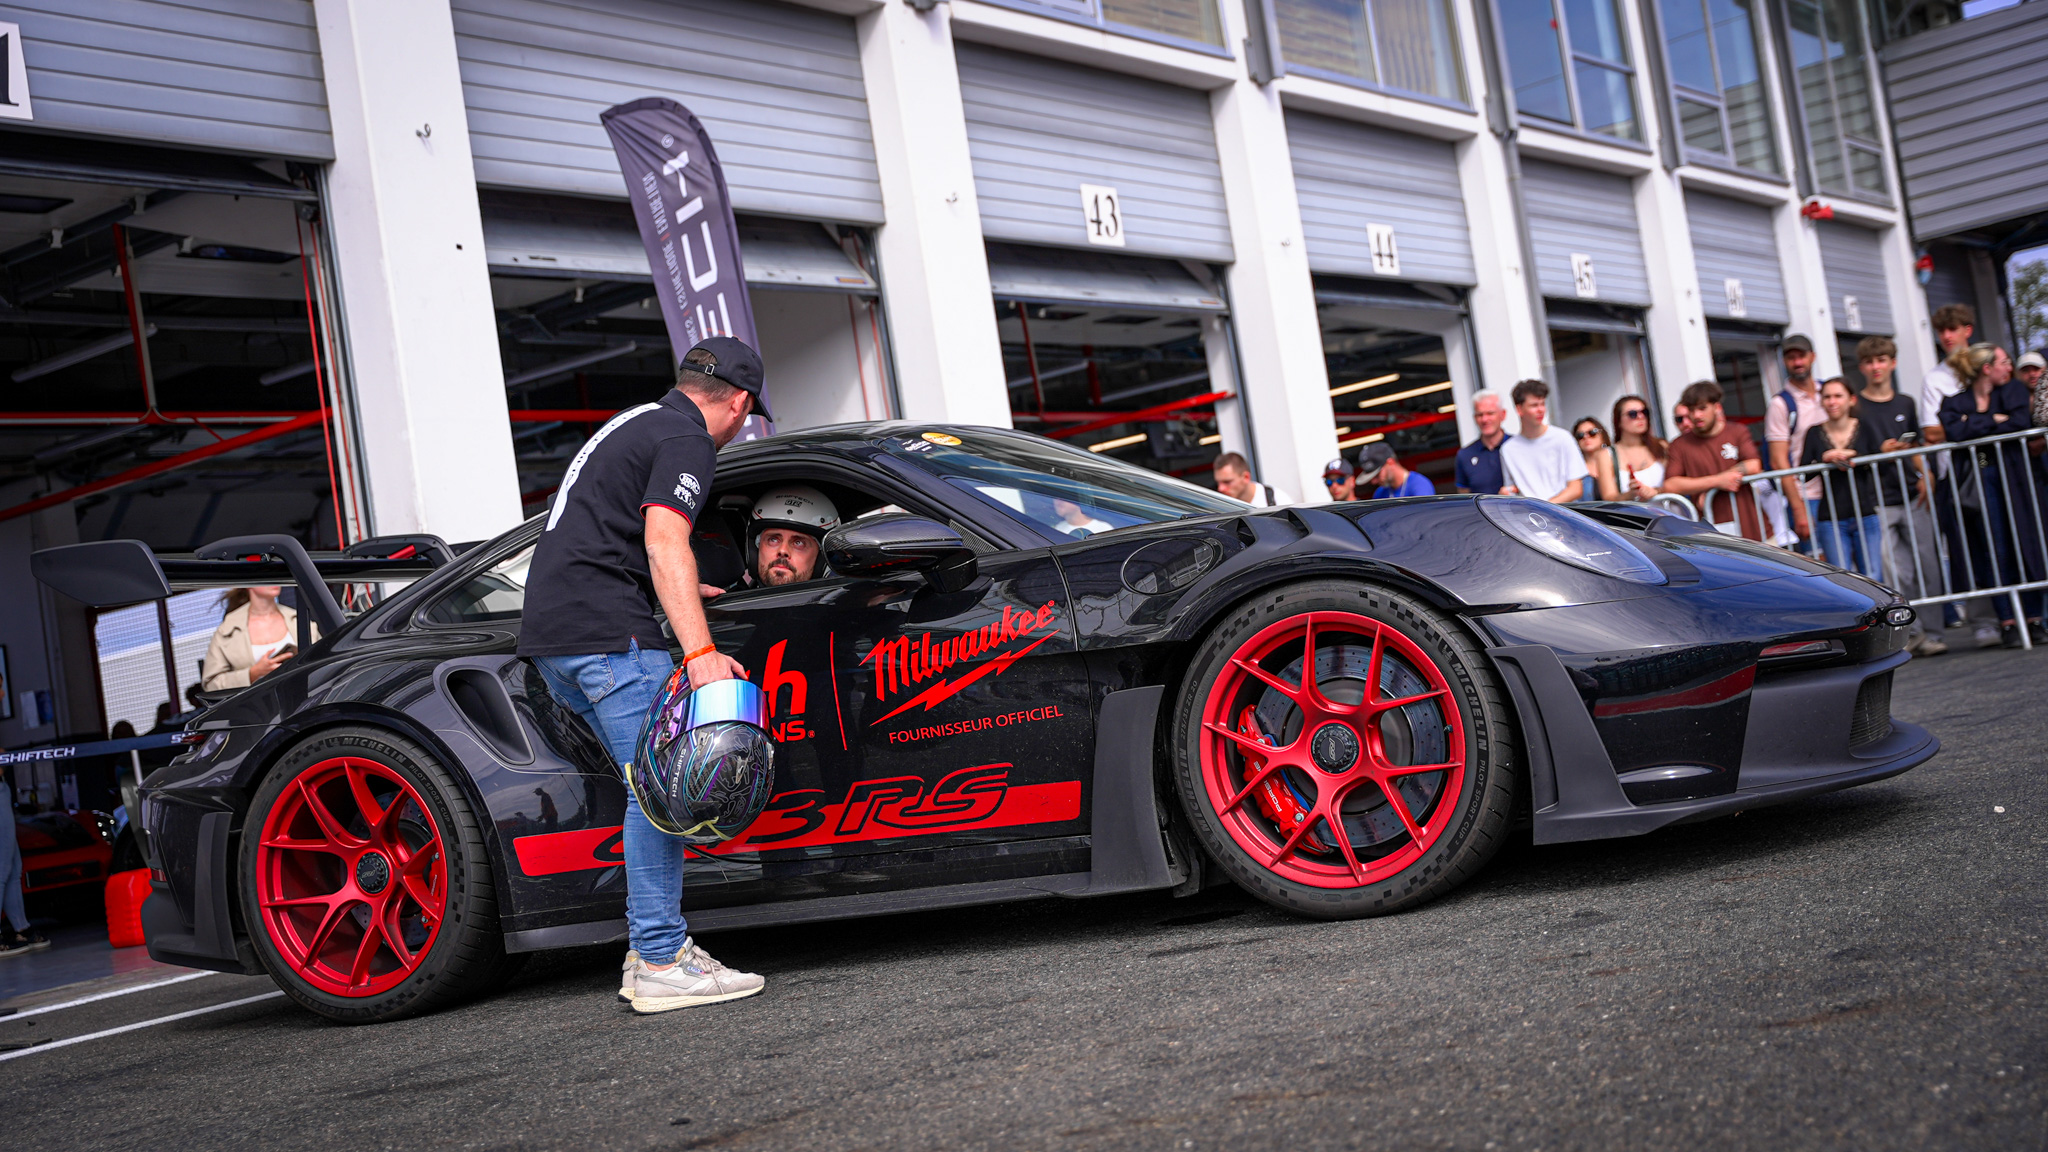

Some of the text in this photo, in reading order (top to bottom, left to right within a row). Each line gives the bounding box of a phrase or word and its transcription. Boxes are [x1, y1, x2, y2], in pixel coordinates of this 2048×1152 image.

[1089, 194, 1119, 238] 43
[1373, 232, 1396, 268] 44
[859, 604, 1056, 702] Milwaukee
[888, 705, 1064, 744] FOURNISSEUR OFFICIEL
[1452, 662, 1487, 751] MICHELIN
[0, 747, 76, 764] SHIFTECH
[342, 736, 409, 764] MICHELIN
[408, 764, 428, 782] PILOT
[425, 782, 442, 806] SPORT
[671, 748, 687, 798] SHIFTECH
[1477, 759, 1486, 788] PILOT
[1179, 748, 1211, 833] MICHELIN
[1468, 789, 1482, 821] SPORT
[1458, 823, 1470, 841] CUP
